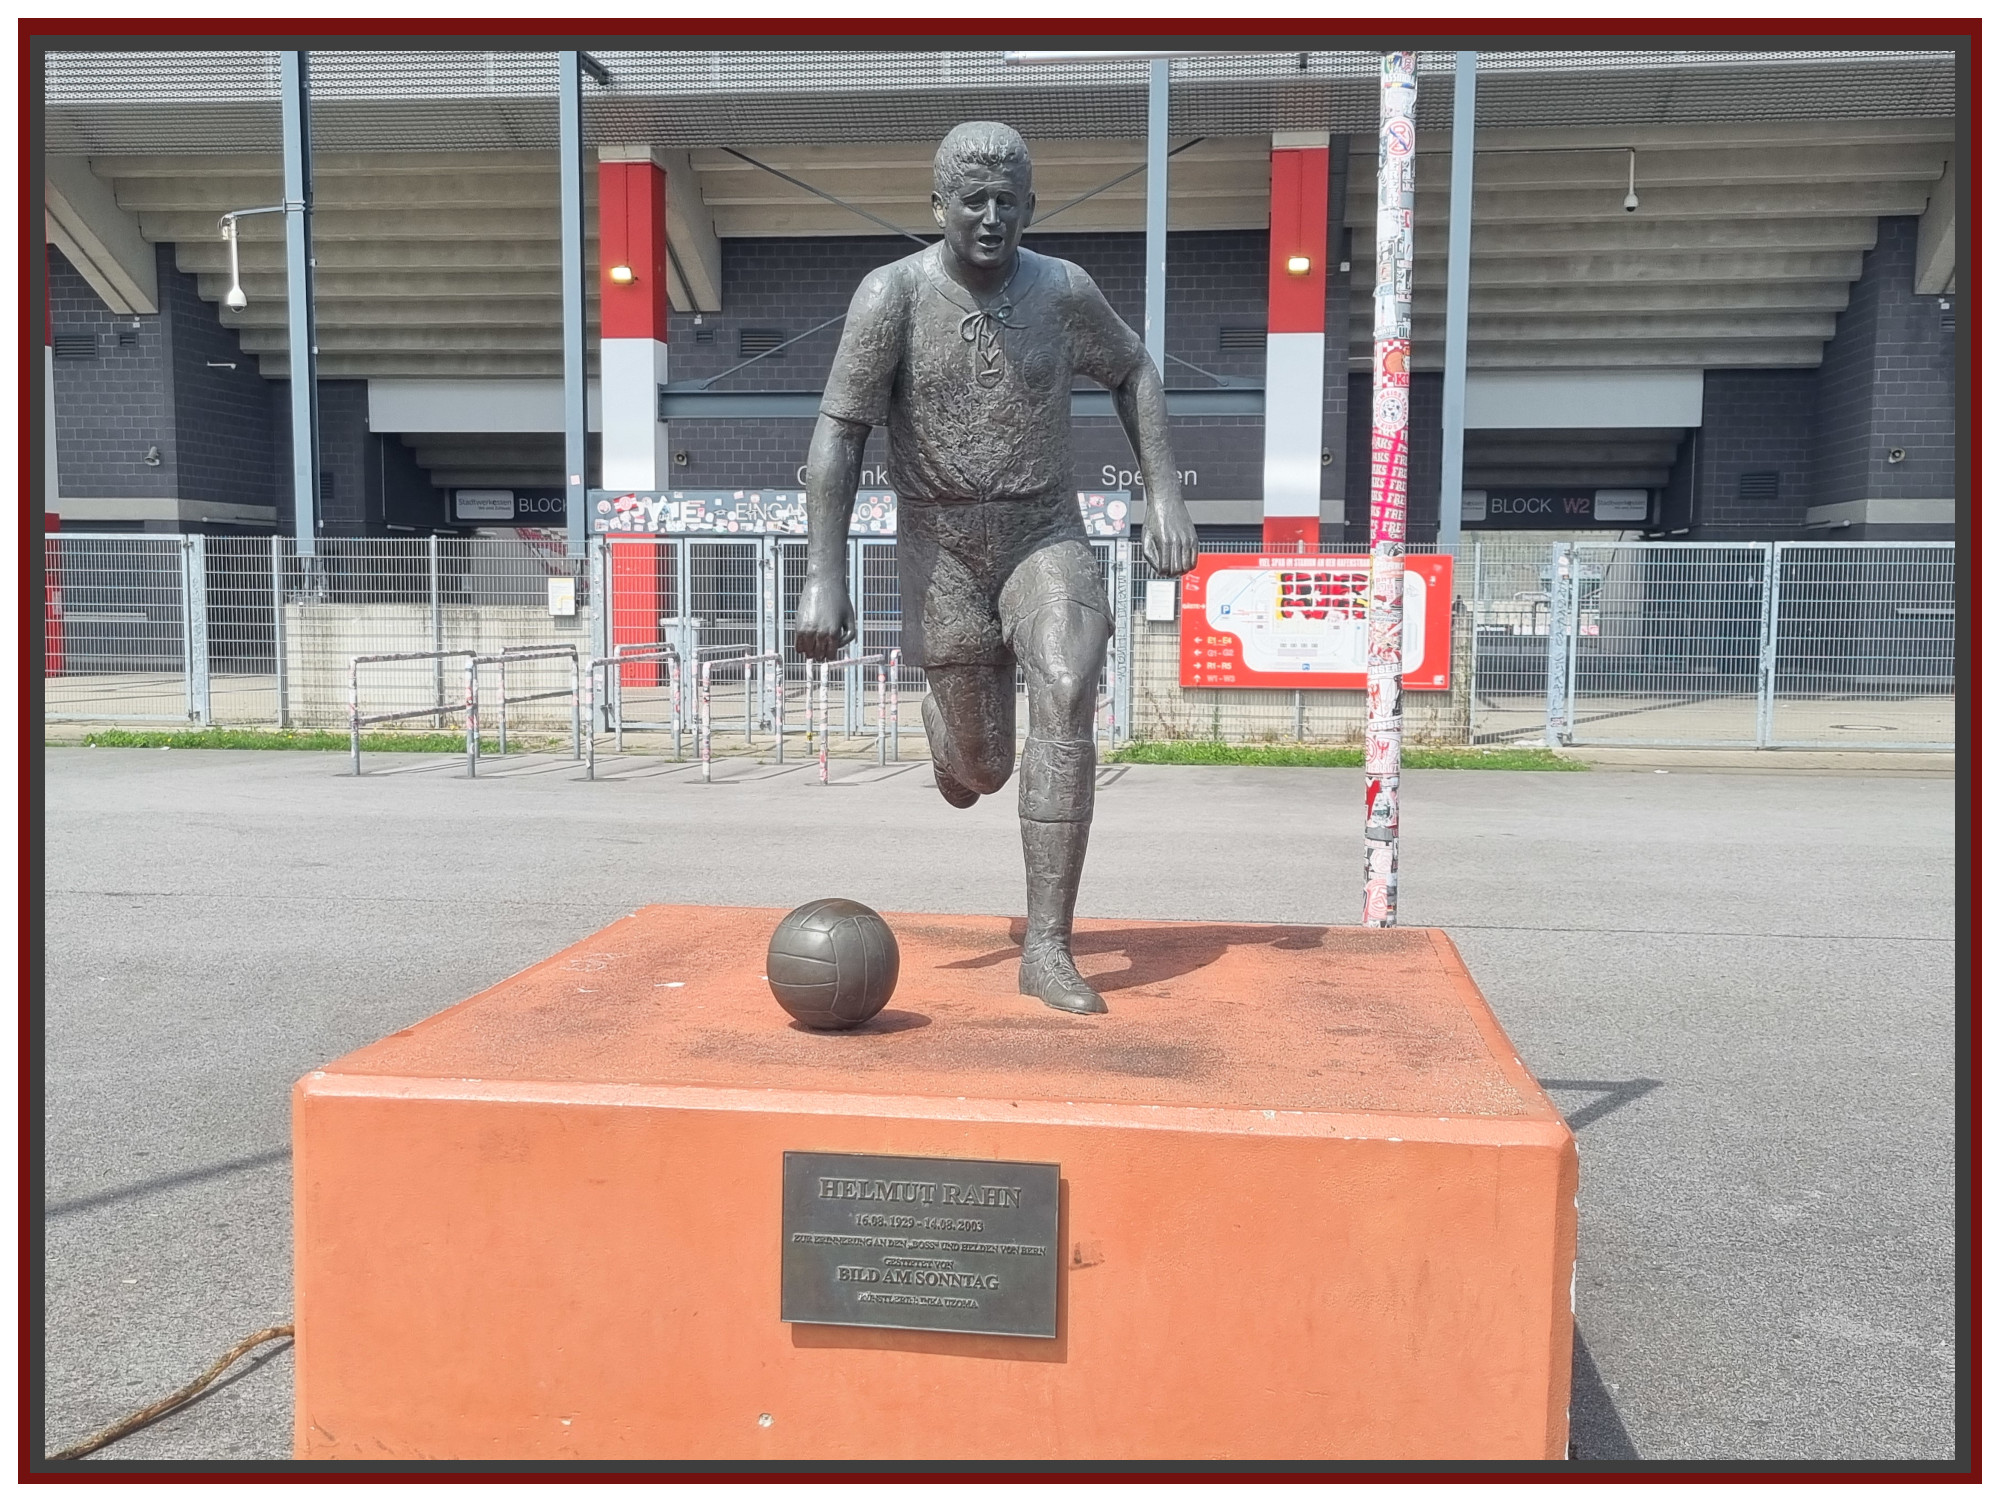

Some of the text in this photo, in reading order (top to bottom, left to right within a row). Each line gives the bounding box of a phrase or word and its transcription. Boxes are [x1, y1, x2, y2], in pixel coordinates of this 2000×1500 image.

[1101, 464, 1198, 491] Spen
[1492, 498, 1552, 513] BLOCK
[1563, 498, 1590, 513] W2
[819, 1177, 1022, 1208] HELMUT RAHN
[889, 1215, 915, 1229] 1929
[958, 1219, 984, 1233] 2003
[793, 1232, 813, 1244] ZUR
[813, 1234, 873, 1248] ERINNERUNG
[873, 1237, 887, 1247] AN
[887, 1238, 908, 1249] DEN
[940, 1241, 960, 1252] UND
[961, 1242, 999, 1255] HELDEN
[1000, 1245, 1020, 1256] VON
[1020, 1246, 1047, 1257] BERN
[883, 1256, 955, 1270] GESTIFTET VON
[838, 1266, 999, 1291] BILD AM SONNTAG
